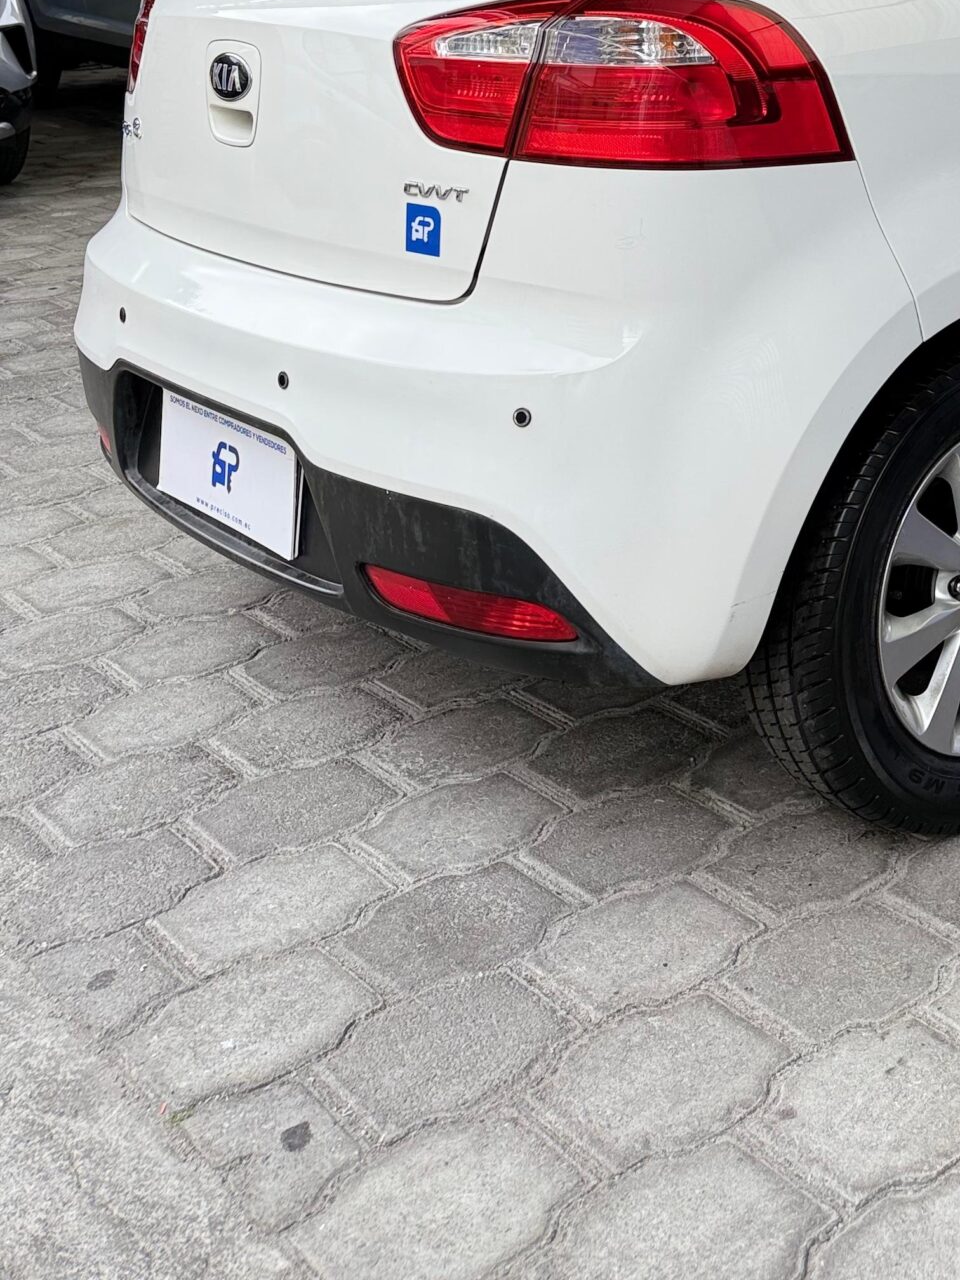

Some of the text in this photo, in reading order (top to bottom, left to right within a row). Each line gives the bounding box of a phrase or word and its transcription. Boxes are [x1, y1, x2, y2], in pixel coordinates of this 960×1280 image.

[212, 62, 242, 92] KIA
[404, 181, 469, 203] CVVT
[170, 395, 186, 408] SOMOS
[191, 405, 203, 416] NEXO
[204, 410, 218, 422] ENTRE
[219, 416, 252, 438] COMPRADORES
[256, 434, 287, 455] VENDEDORES
[196, 496, 252, 531] www.preciso.com.ec
